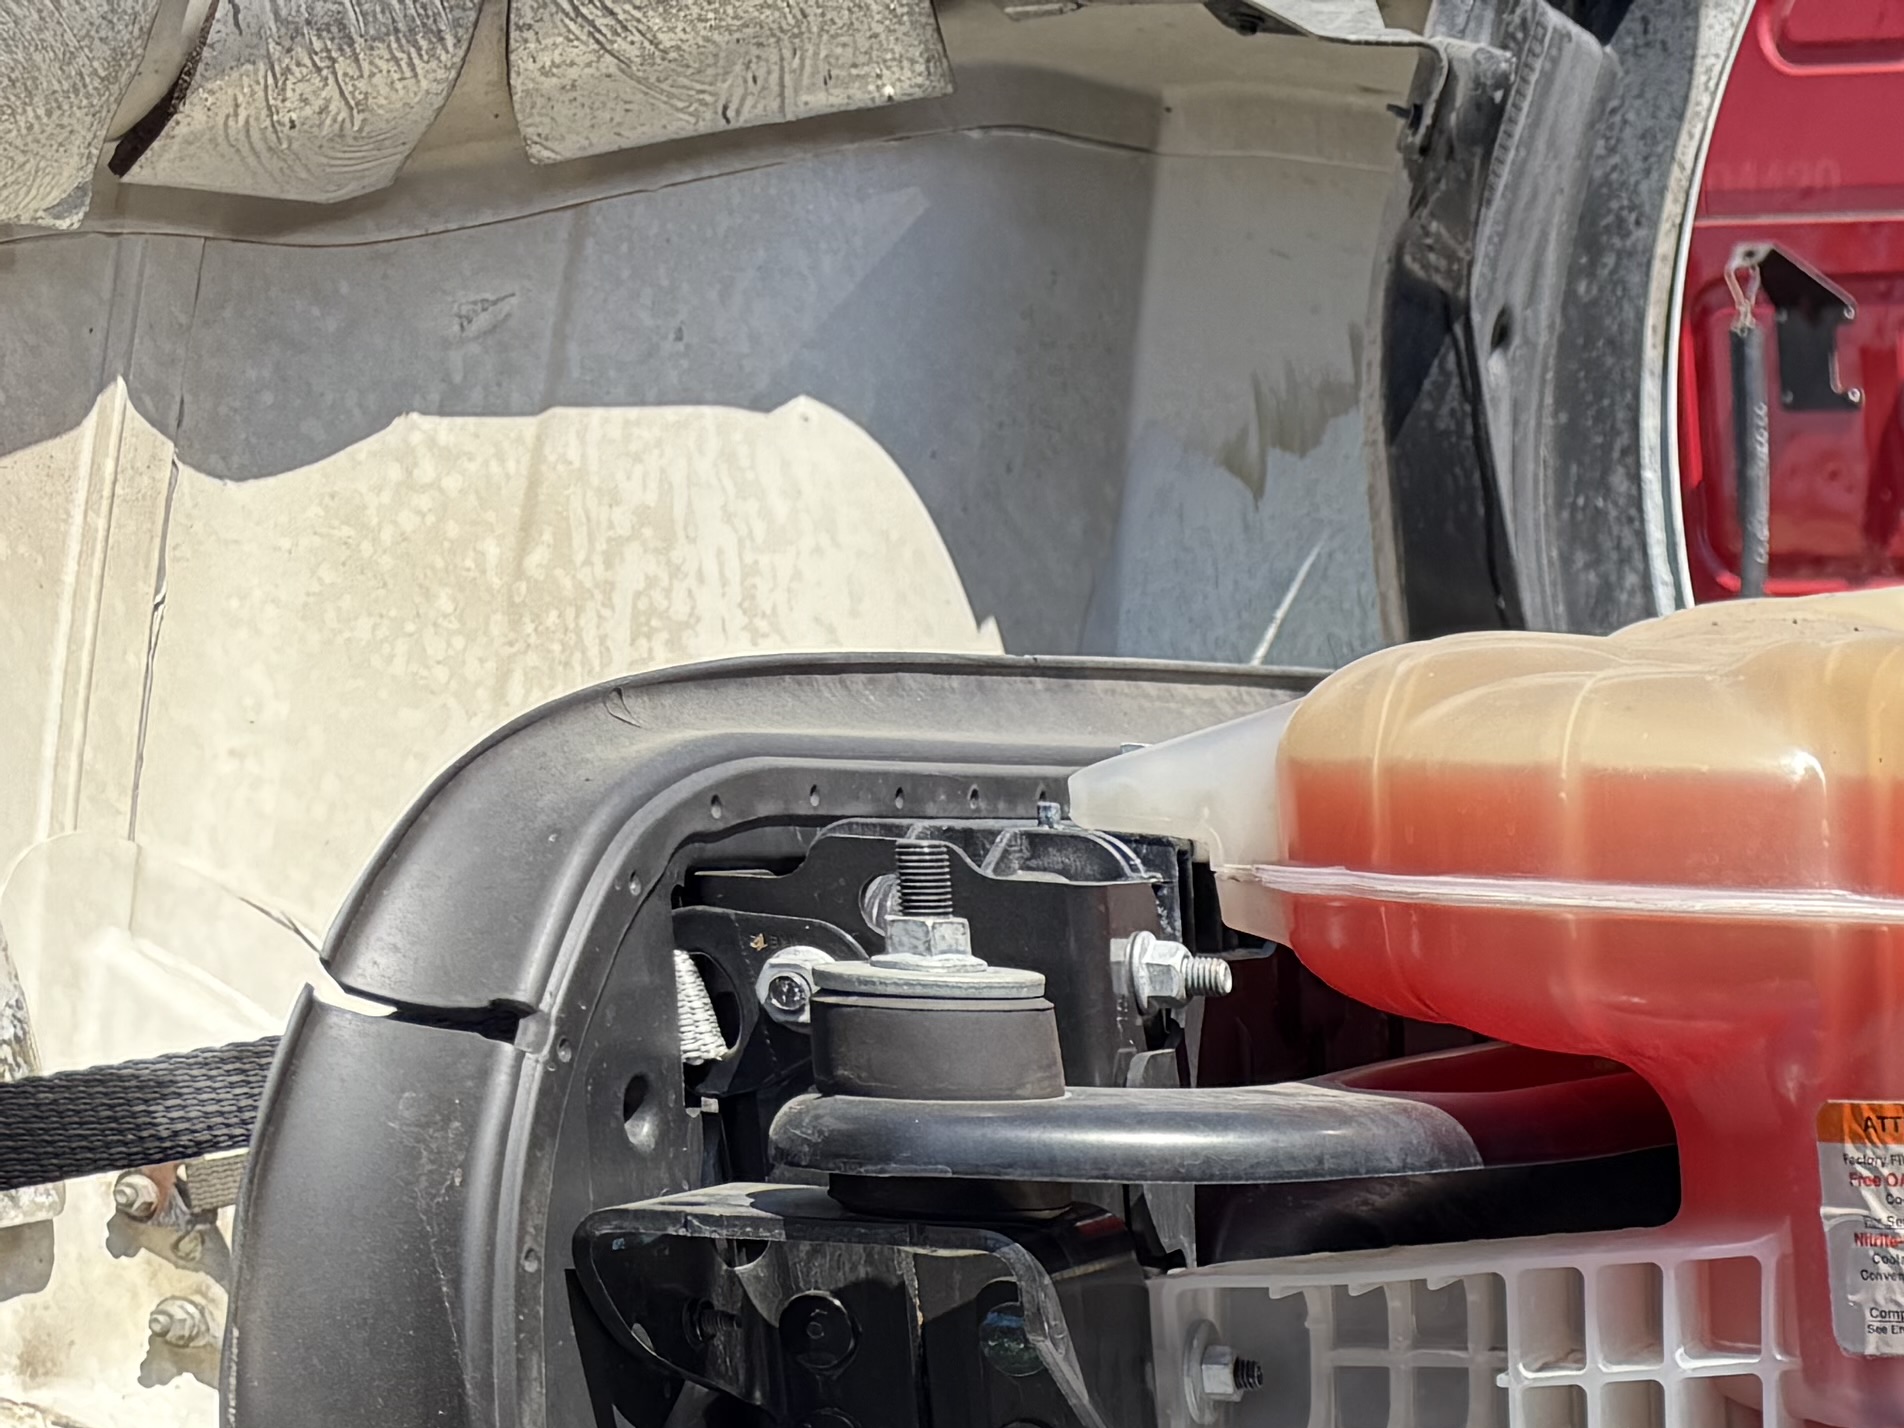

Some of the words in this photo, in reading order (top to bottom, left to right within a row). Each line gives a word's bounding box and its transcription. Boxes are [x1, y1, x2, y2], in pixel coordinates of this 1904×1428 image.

[1843, 1152, 1887, 1167] Factory
[1849, 1173, 1881, 1187] Free
[1867, 1324, 1888, 1334] See
